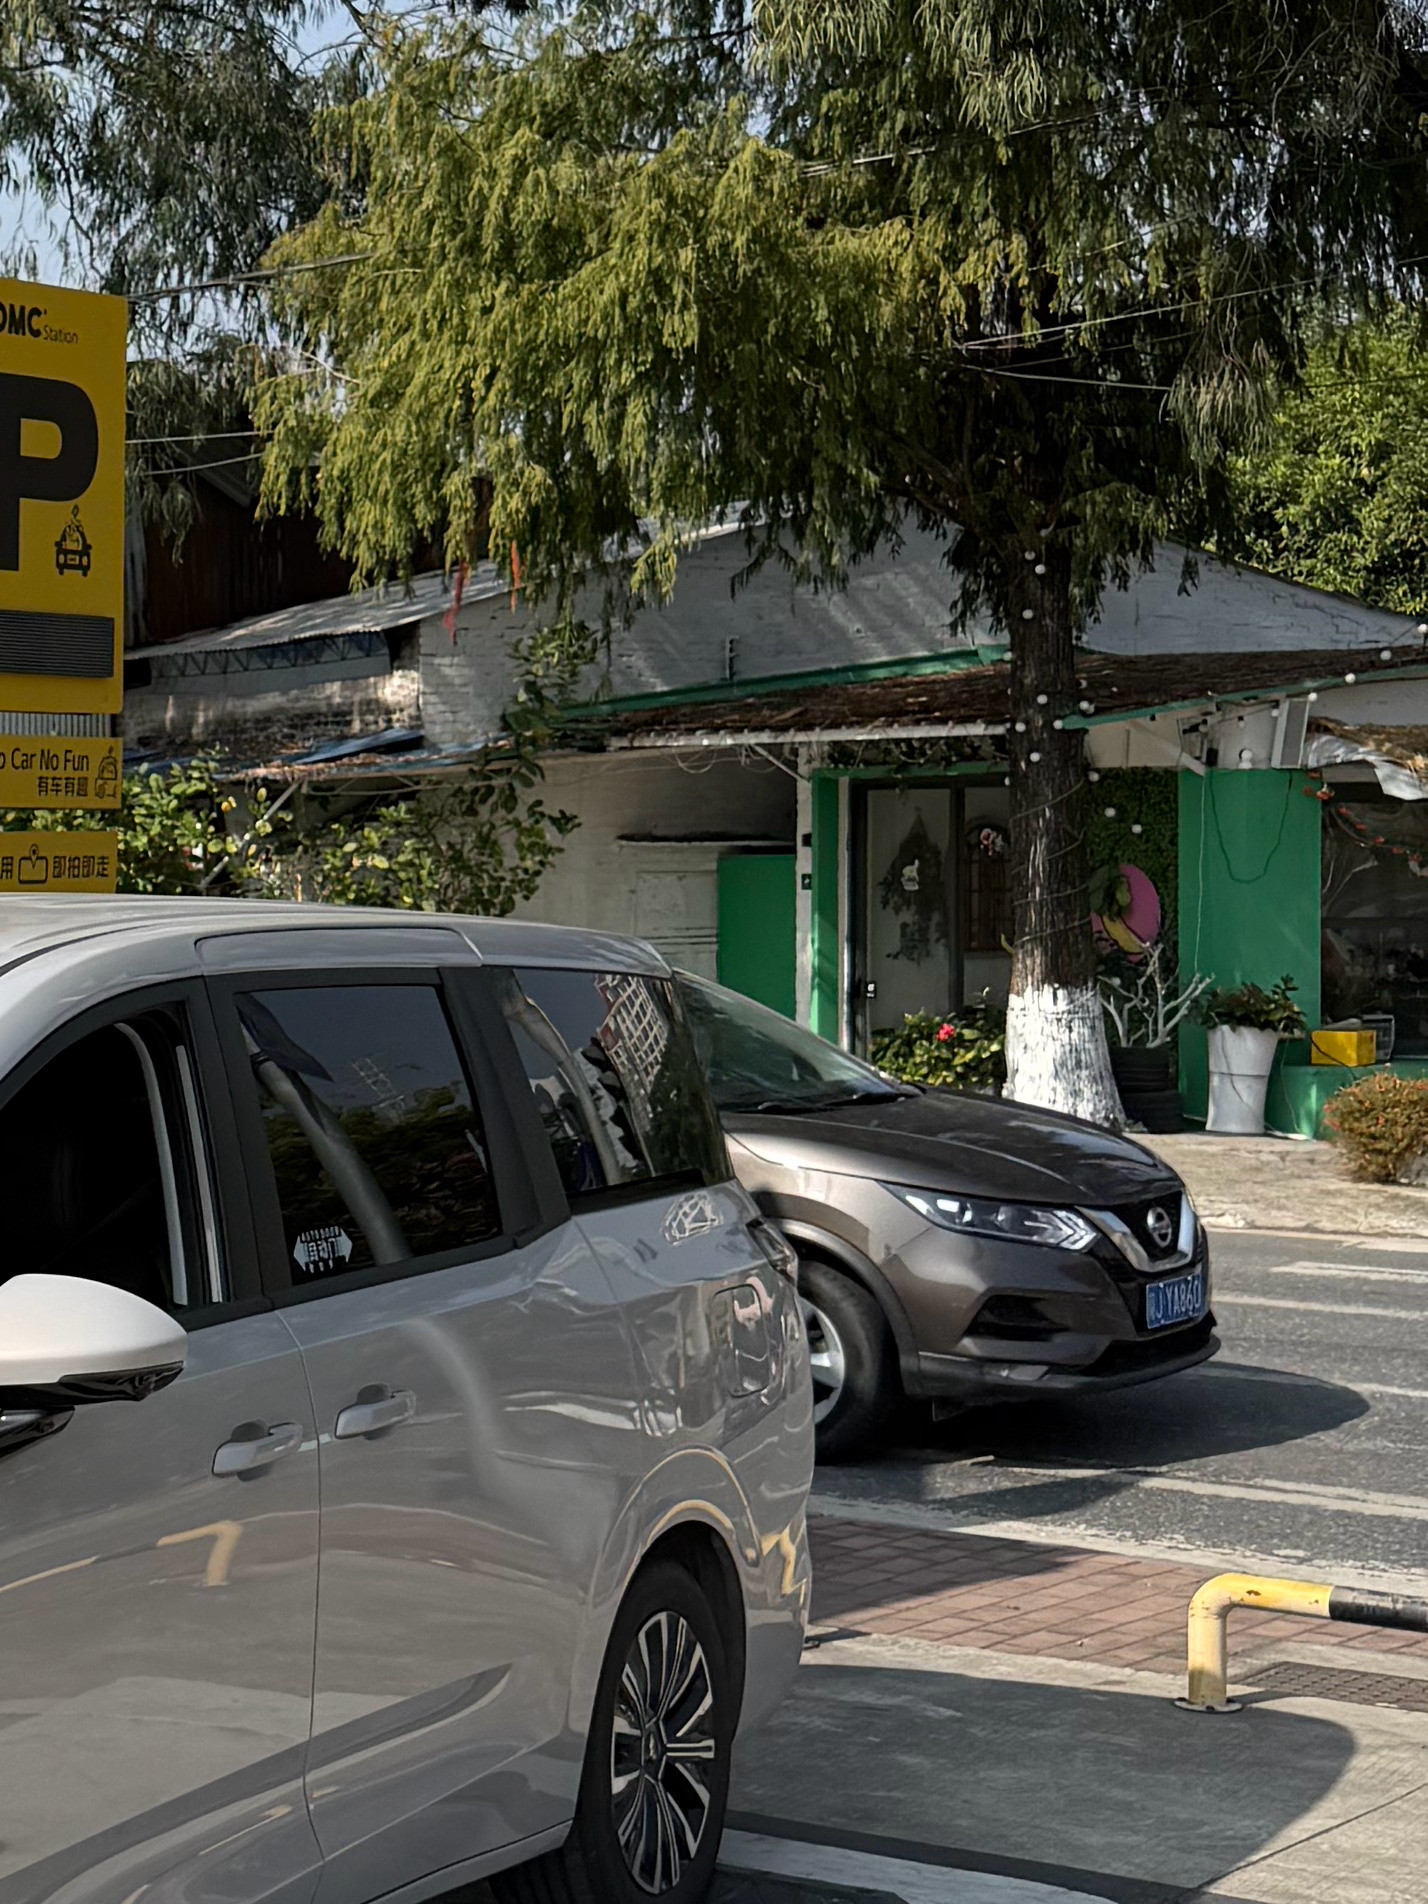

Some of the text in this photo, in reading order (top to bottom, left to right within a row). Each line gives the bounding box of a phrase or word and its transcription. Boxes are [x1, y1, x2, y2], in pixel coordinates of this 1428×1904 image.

[42, 324, 79, 345] Station
[11, 747, 37, 771] Car
[40, 748, 60, 772] No
[64, 749, 90, 772] Fun
[52, 854, 110, 879] 即拍即走
